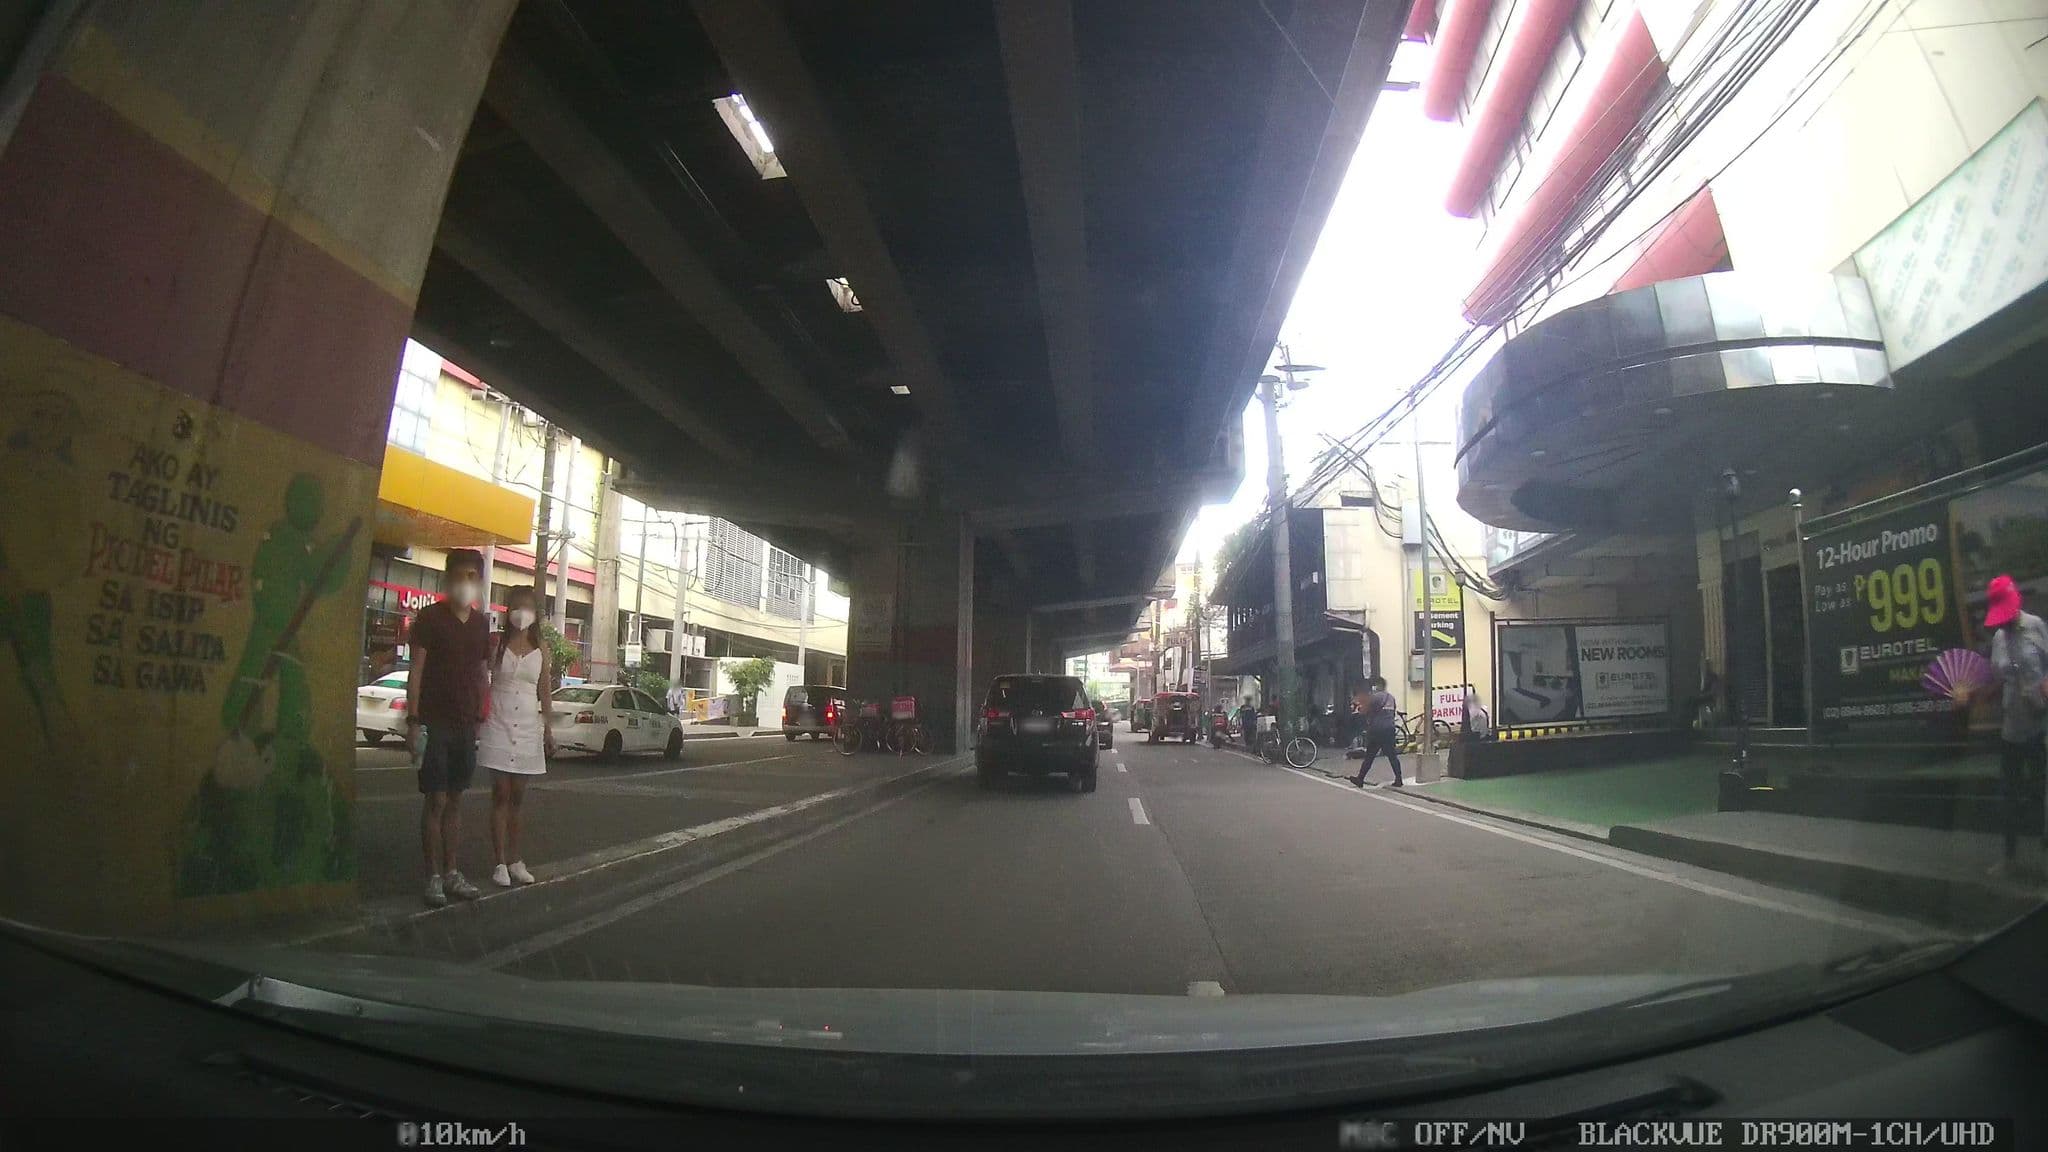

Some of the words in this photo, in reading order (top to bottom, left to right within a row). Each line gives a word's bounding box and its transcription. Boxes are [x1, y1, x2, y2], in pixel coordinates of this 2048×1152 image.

[129, 442, 180, 481] AKO
[186, 463, 220, 490] AY
[107, 471, 239, 533] TAGLINIS
[143, 517, 180, 550] NG
[1816, 538, 1879, 570] 12-Hour
[1881, 523, 1938, 554] Promo
[101, 579, 133, 613] SA
[1814, 583, 1832, 598] Pay
[1835, 583, 1847, 593] as
[1815, 600, 1835, 613] Low
[1839, 599, 1851, 609] as
[86, 613, 122, 646] SA
[1581, 647, 1615, 661] NEW
[1617, 645, 1665, 660] ROOMS
[1860, 638, 1938, 660] EUROTEL
[1440, 694, 1464, 703] FULL
